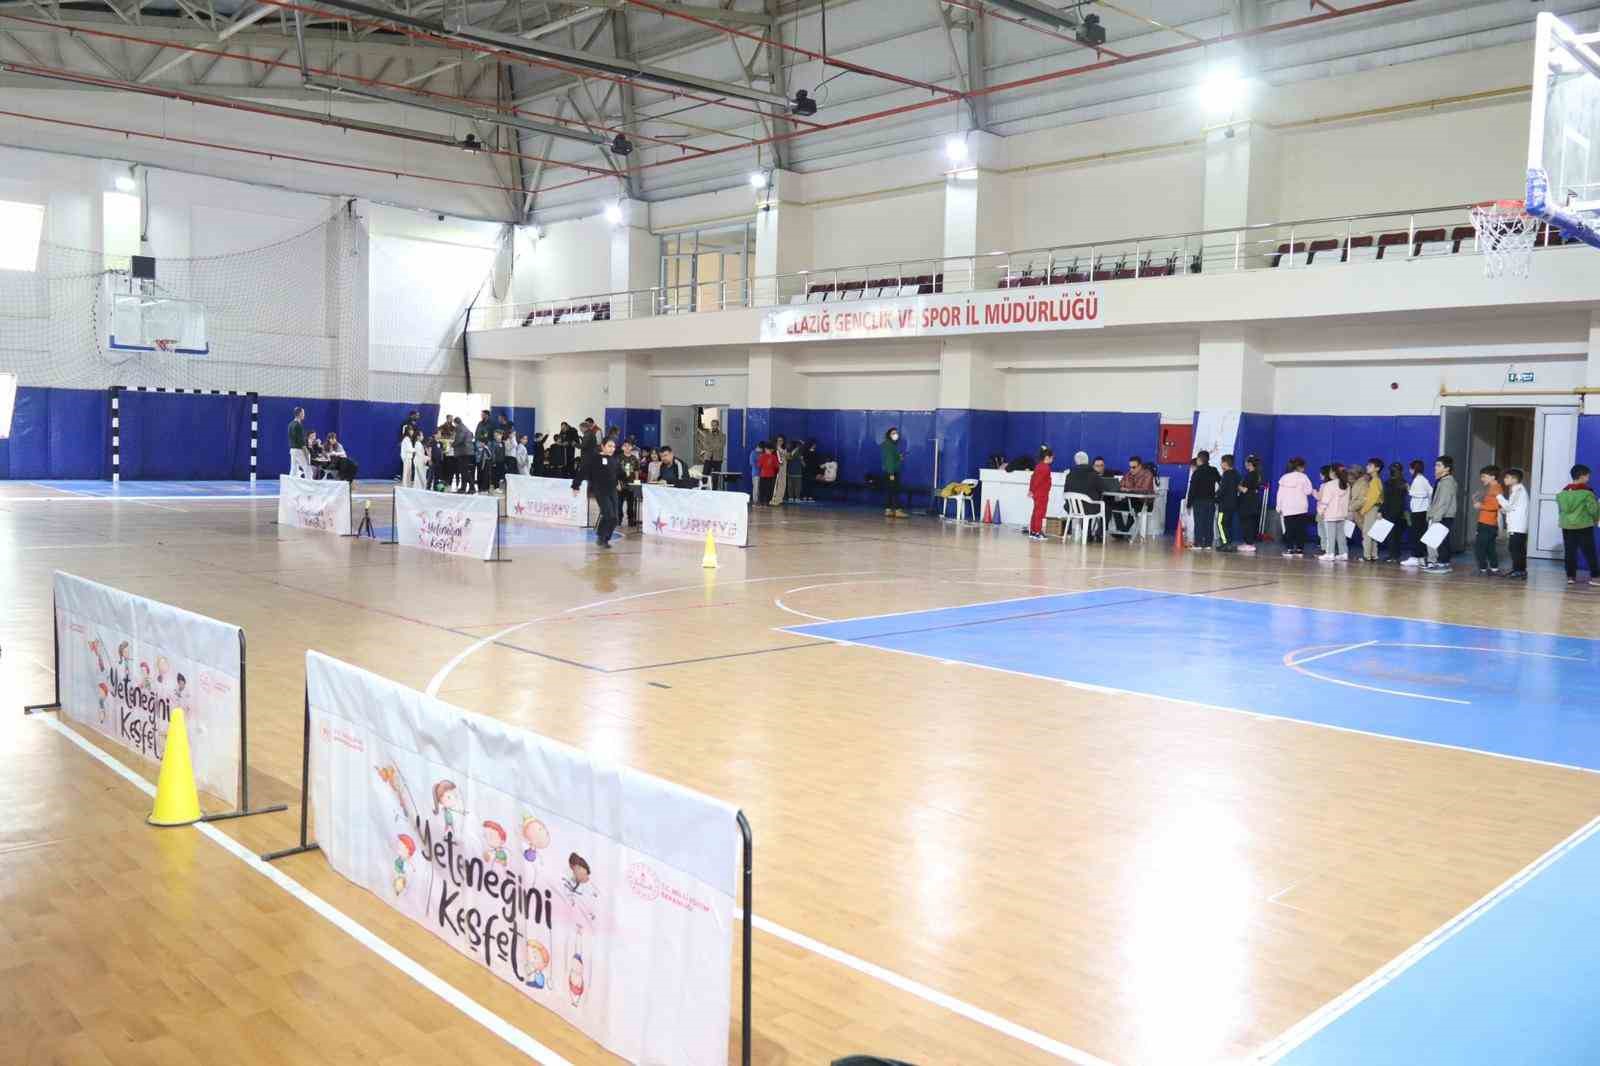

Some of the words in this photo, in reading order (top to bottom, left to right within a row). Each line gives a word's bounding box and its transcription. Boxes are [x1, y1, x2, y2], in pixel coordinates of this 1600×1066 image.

[922, 305, 961, 328] SPOR
[966, 299, 980, 326] İL
[985, 290, 1098, 325] MÜDÜRLÜĞÜ
[110, 666, 171, 723] Yeteneğini
[120, 707, 164, 761] Keşfet
[416, 815, 552, 930] Yeteneğini
[439, 879, 525, 982] Keşfet
